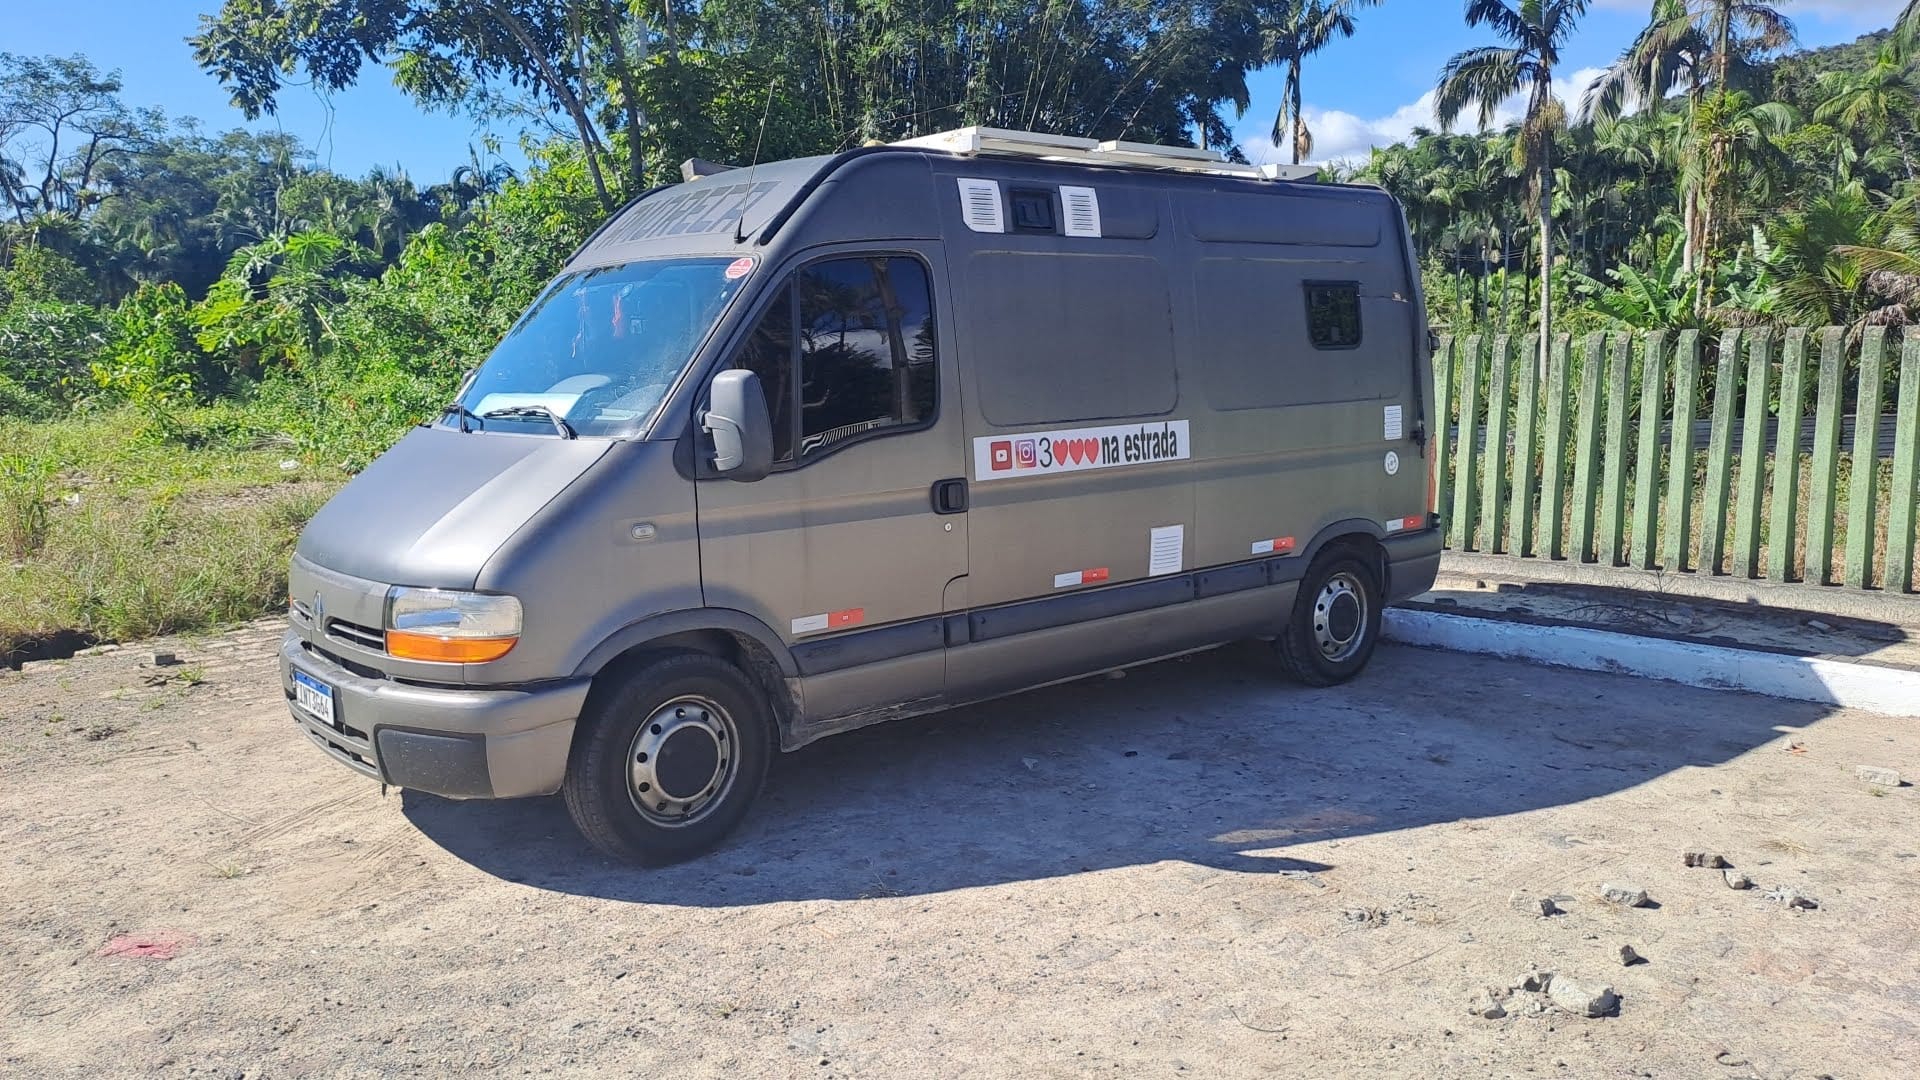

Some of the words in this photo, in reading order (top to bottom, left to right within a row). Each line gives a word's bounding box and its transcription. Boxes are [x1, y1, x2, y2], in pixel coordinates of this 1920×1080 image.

[1038, 437, 1052, 467] 3
[1101, 433, 1120, 464] na
[1124, 422, 1178, 462] estrada
